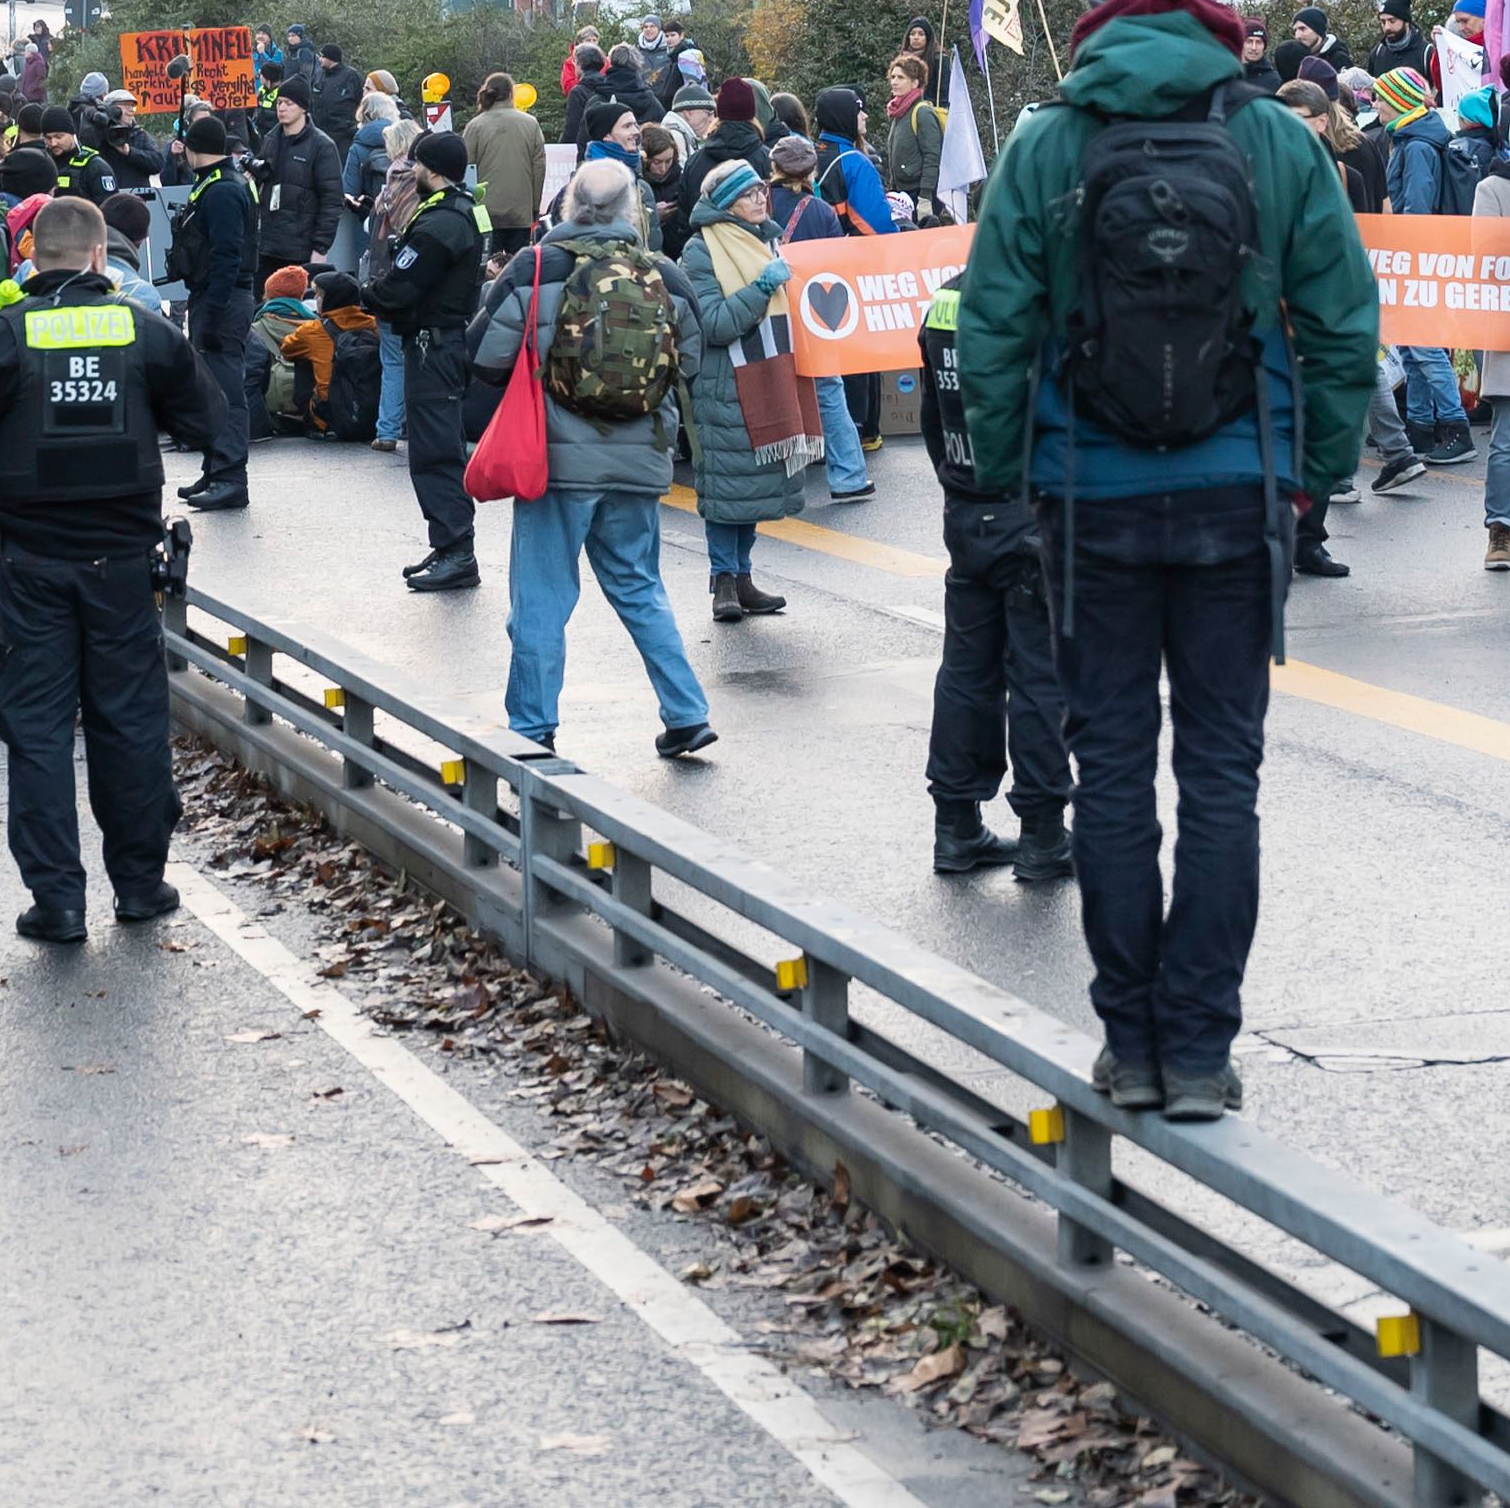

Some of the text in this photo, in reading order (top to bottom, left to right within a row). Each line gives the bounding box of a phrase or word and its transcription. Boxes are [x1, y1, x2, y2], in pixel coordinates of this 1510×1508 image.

[135, 30, 251, 63] KRIMINELL
[196, 63, 229, 79] Recht
[1418, 252, 1475, 280] VON
[856, 271, 919, 302] WEG
[1403, 278, 1439, 308] ZU
[32, 311, 129, 343] POLIZEI
[863, 302, 915, 333] HIN
[69, 356, 100, 378] BE
[937, 370, 960, 391] 353
[50, 380, 118, 402] 35324
